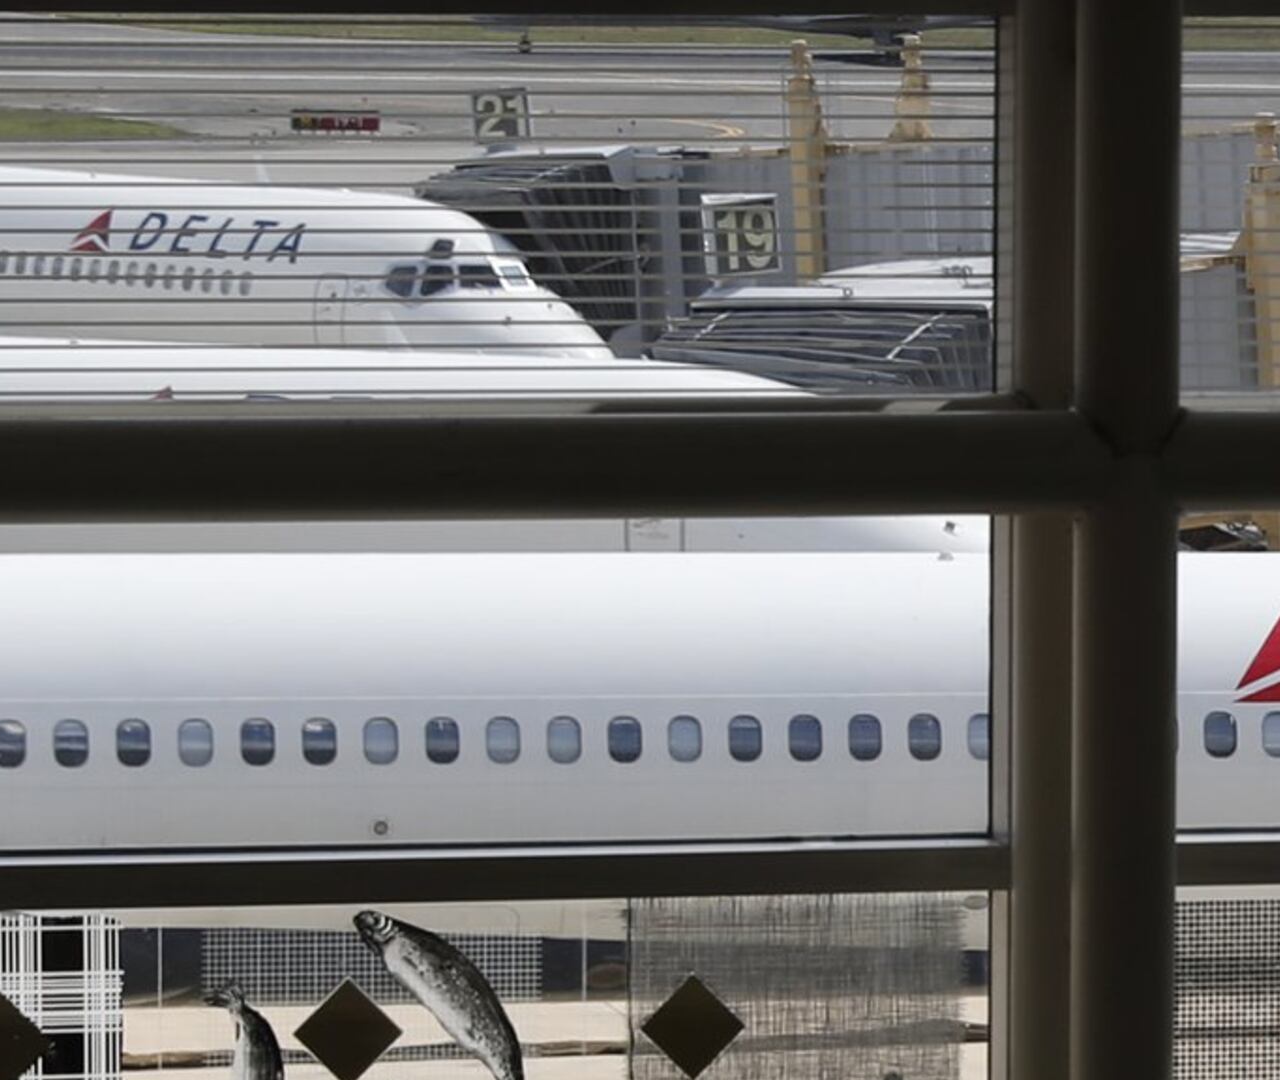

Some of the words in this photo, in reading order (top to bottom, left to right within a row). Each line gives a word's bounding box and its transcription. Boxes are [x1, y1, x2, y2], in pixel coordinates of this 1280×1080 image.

[476, 94, 527, 139] 21
[129, 212, 306, 263] DELTA
[717, 206, 774, 270] 19
